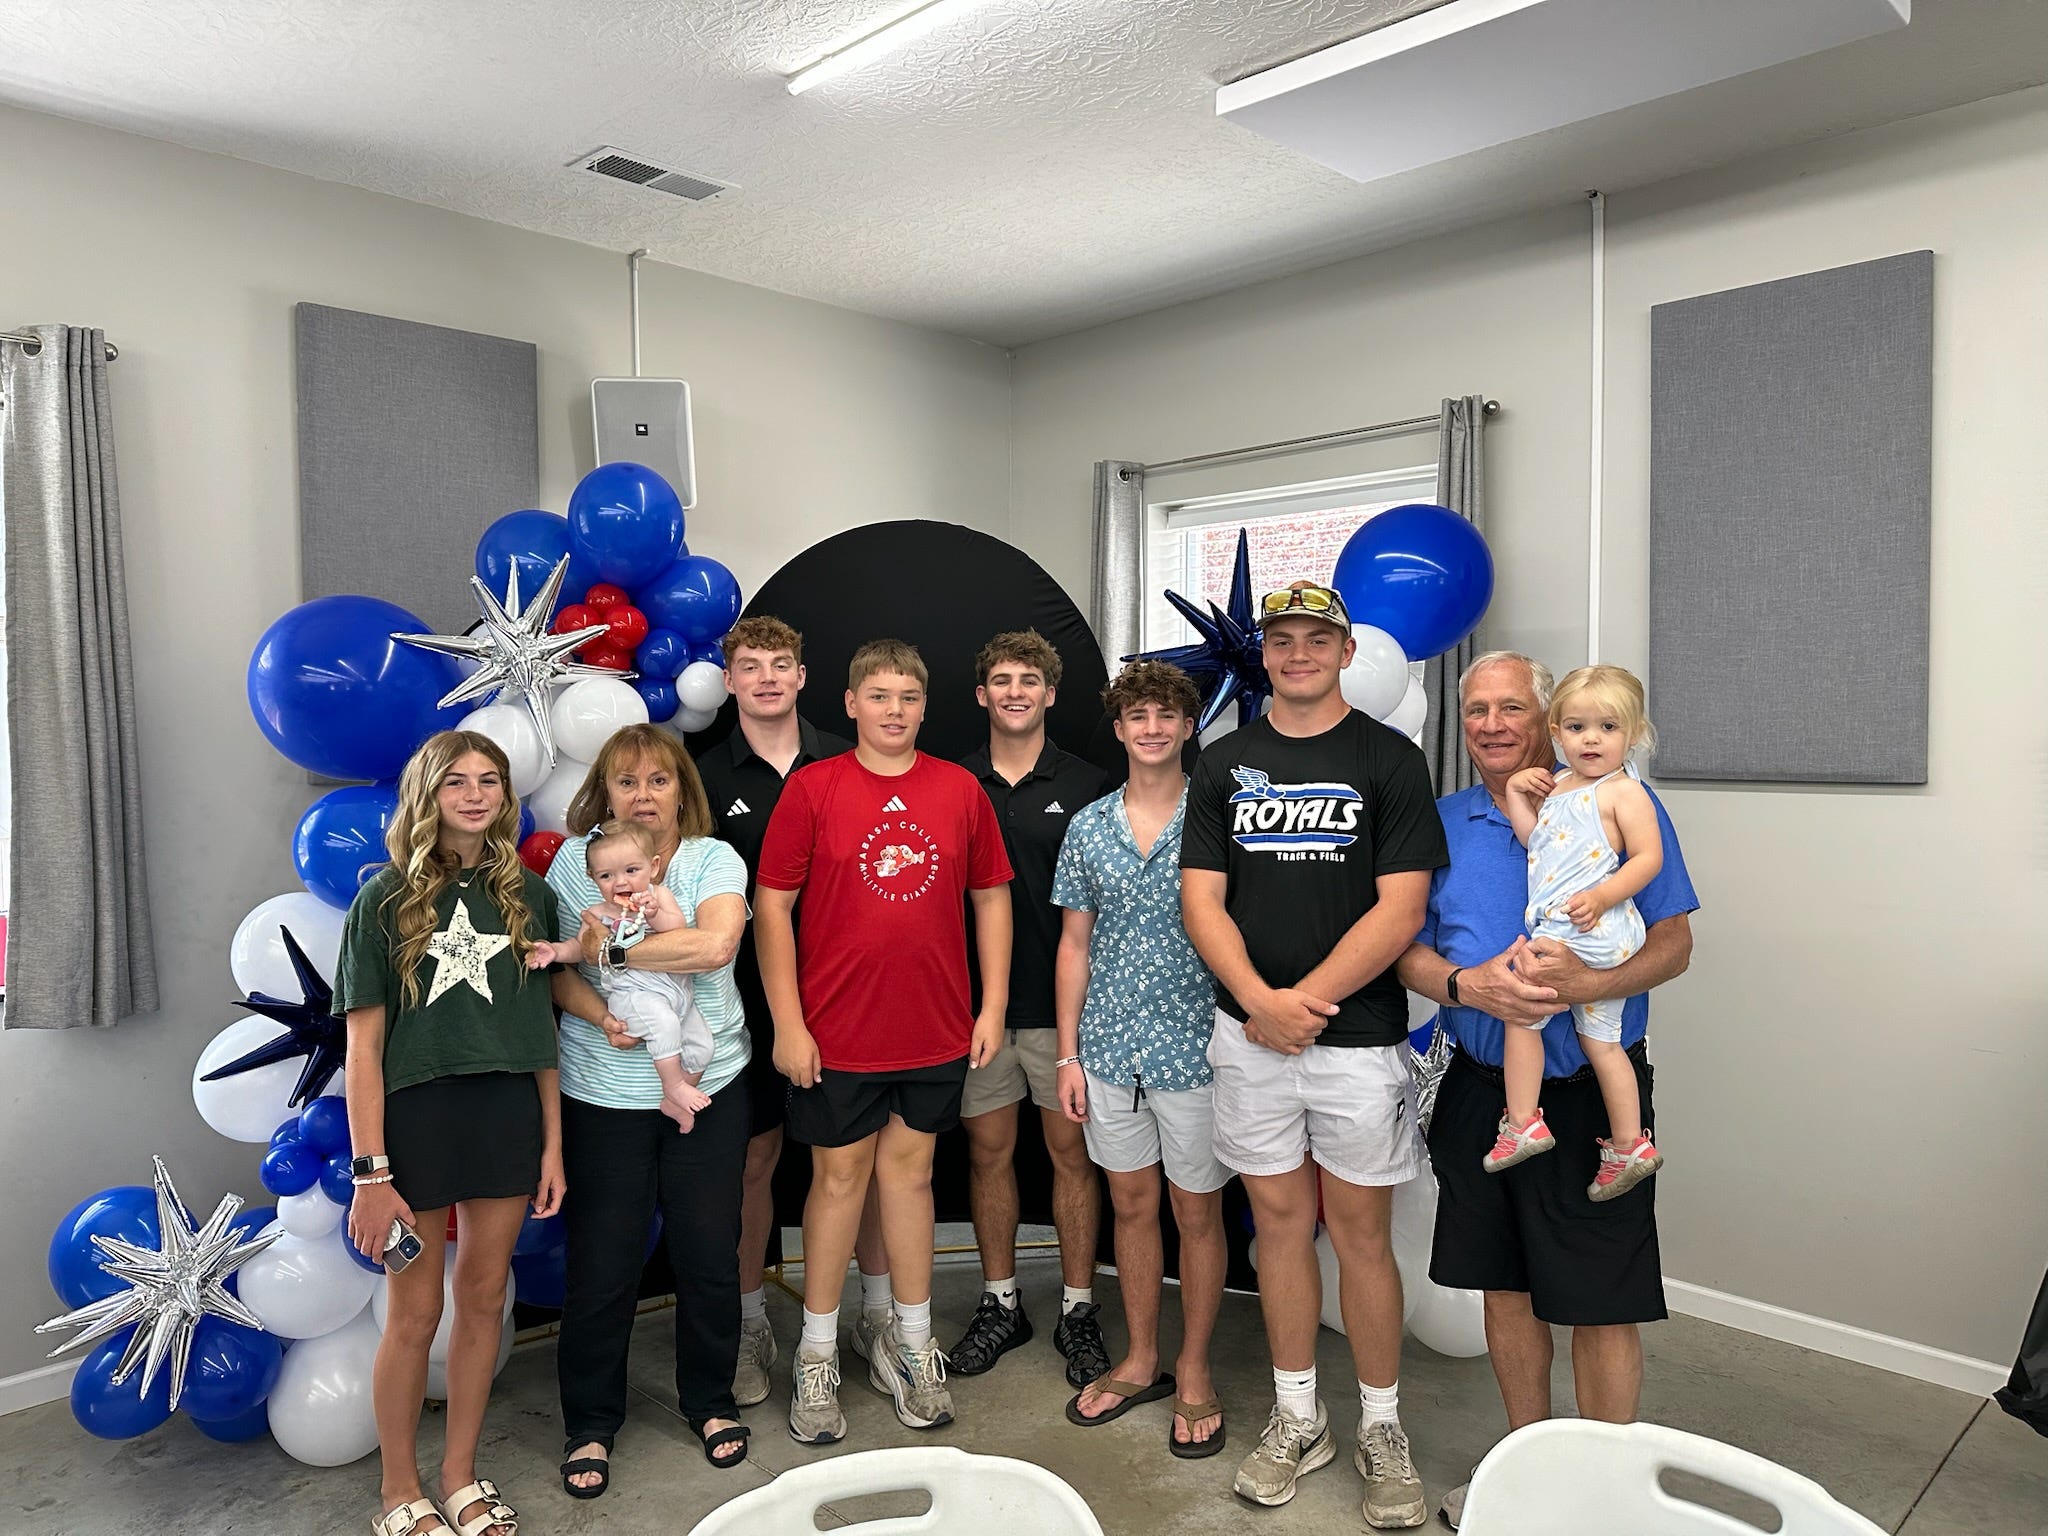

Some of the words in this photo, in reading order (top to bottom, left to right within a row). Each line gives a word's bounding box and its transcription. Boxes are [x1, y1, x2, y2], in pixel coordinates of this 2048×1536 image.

[1233, 799, 1363, 833] ROYALS
[859, 822, 890, 872] WABASH
[900, 821, 939, 871] COLLEGE
[1276, 851, 1307, 861] TRACK
[1309, 851, 1317, 861] &
[1320, 852, 1345, 862] FIELD
[863, 874, 896, 901] LITTLE
[902, 874, 935, 902] GIANTS
